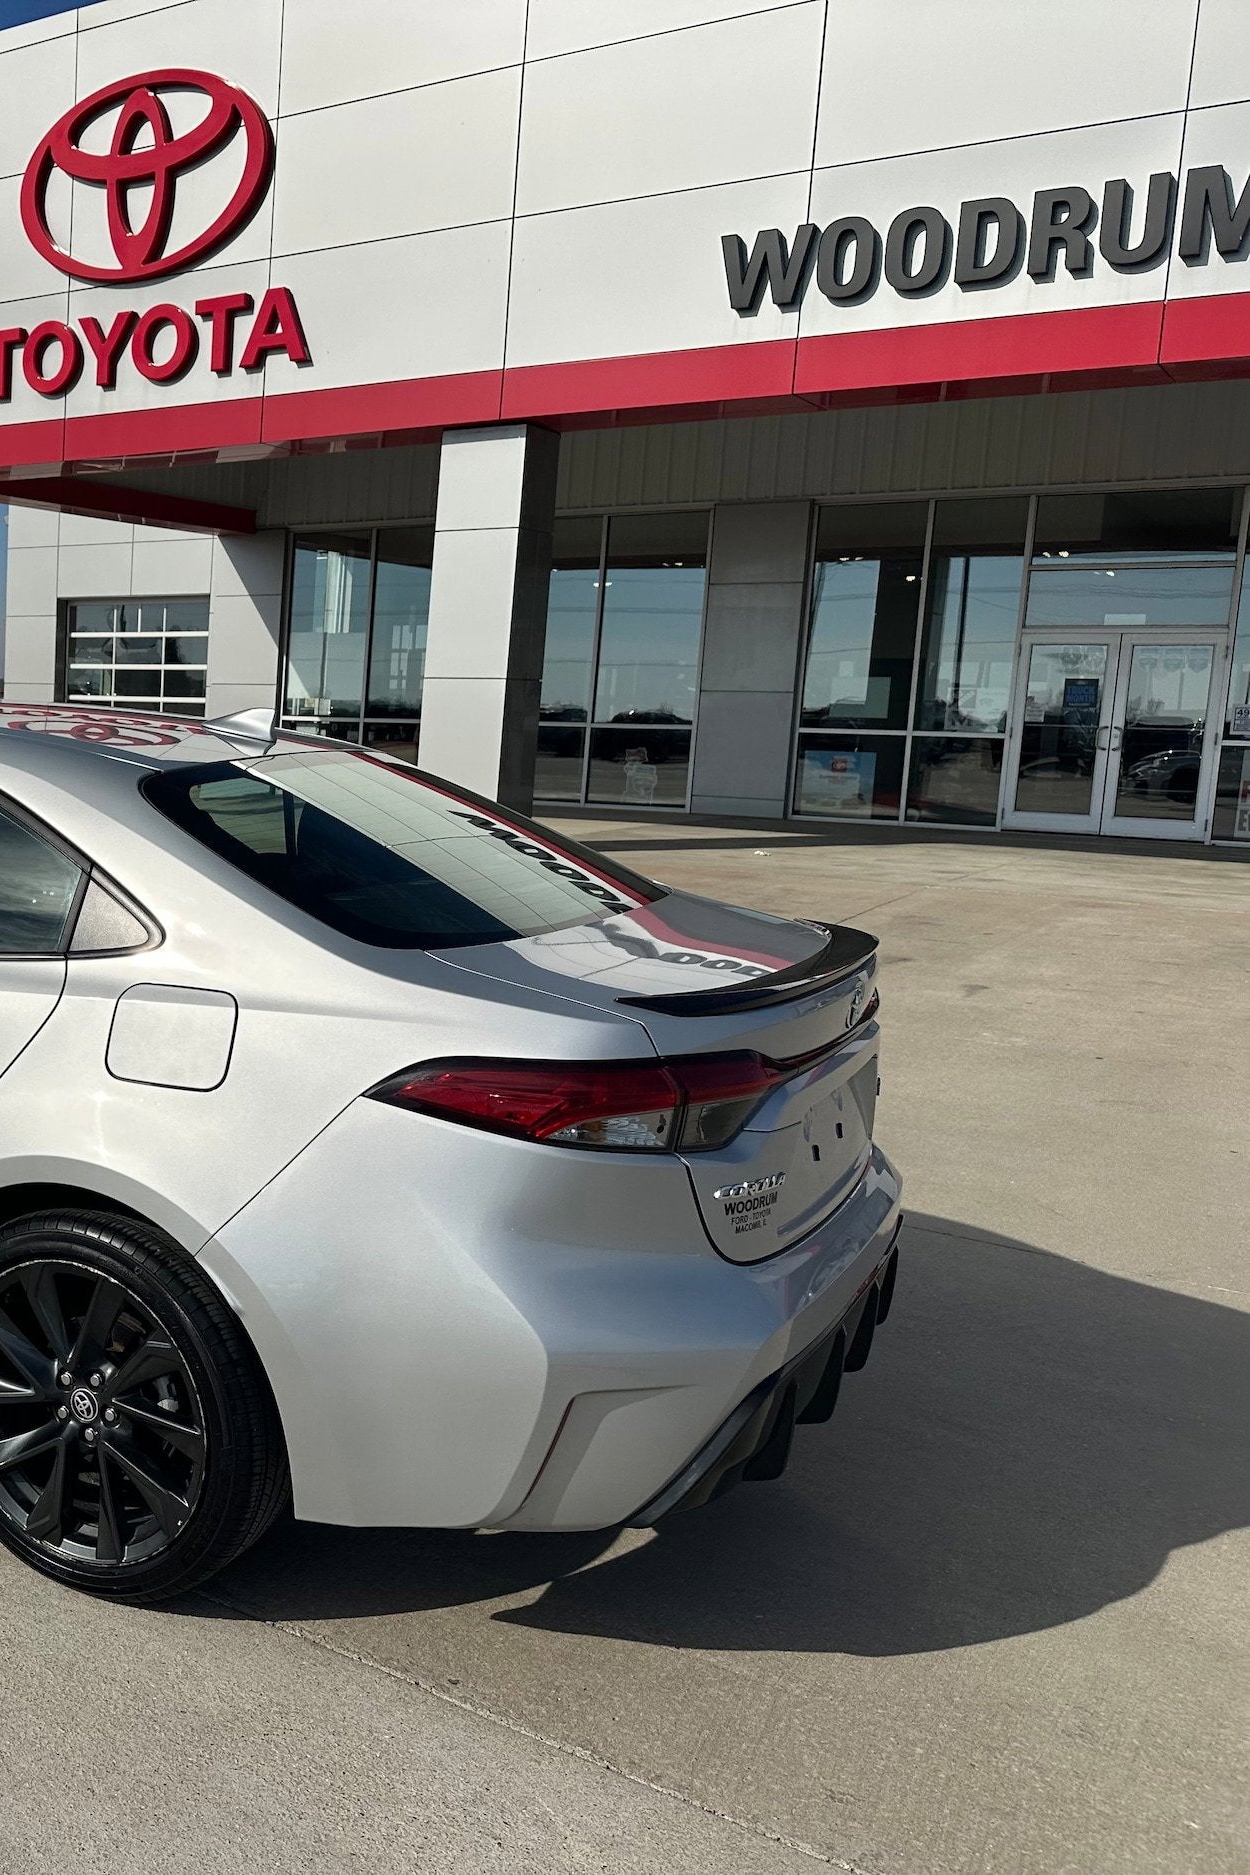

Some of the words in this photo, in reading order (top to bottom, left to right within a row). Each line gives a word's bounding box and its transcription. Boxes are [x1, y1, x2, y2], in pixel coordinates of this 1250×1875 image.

[720, 163, 1250, 319] WOODRUM
[724, 1191, 778, 1216] WOODRUM
[731, 1214, 749, 1226] FORD
